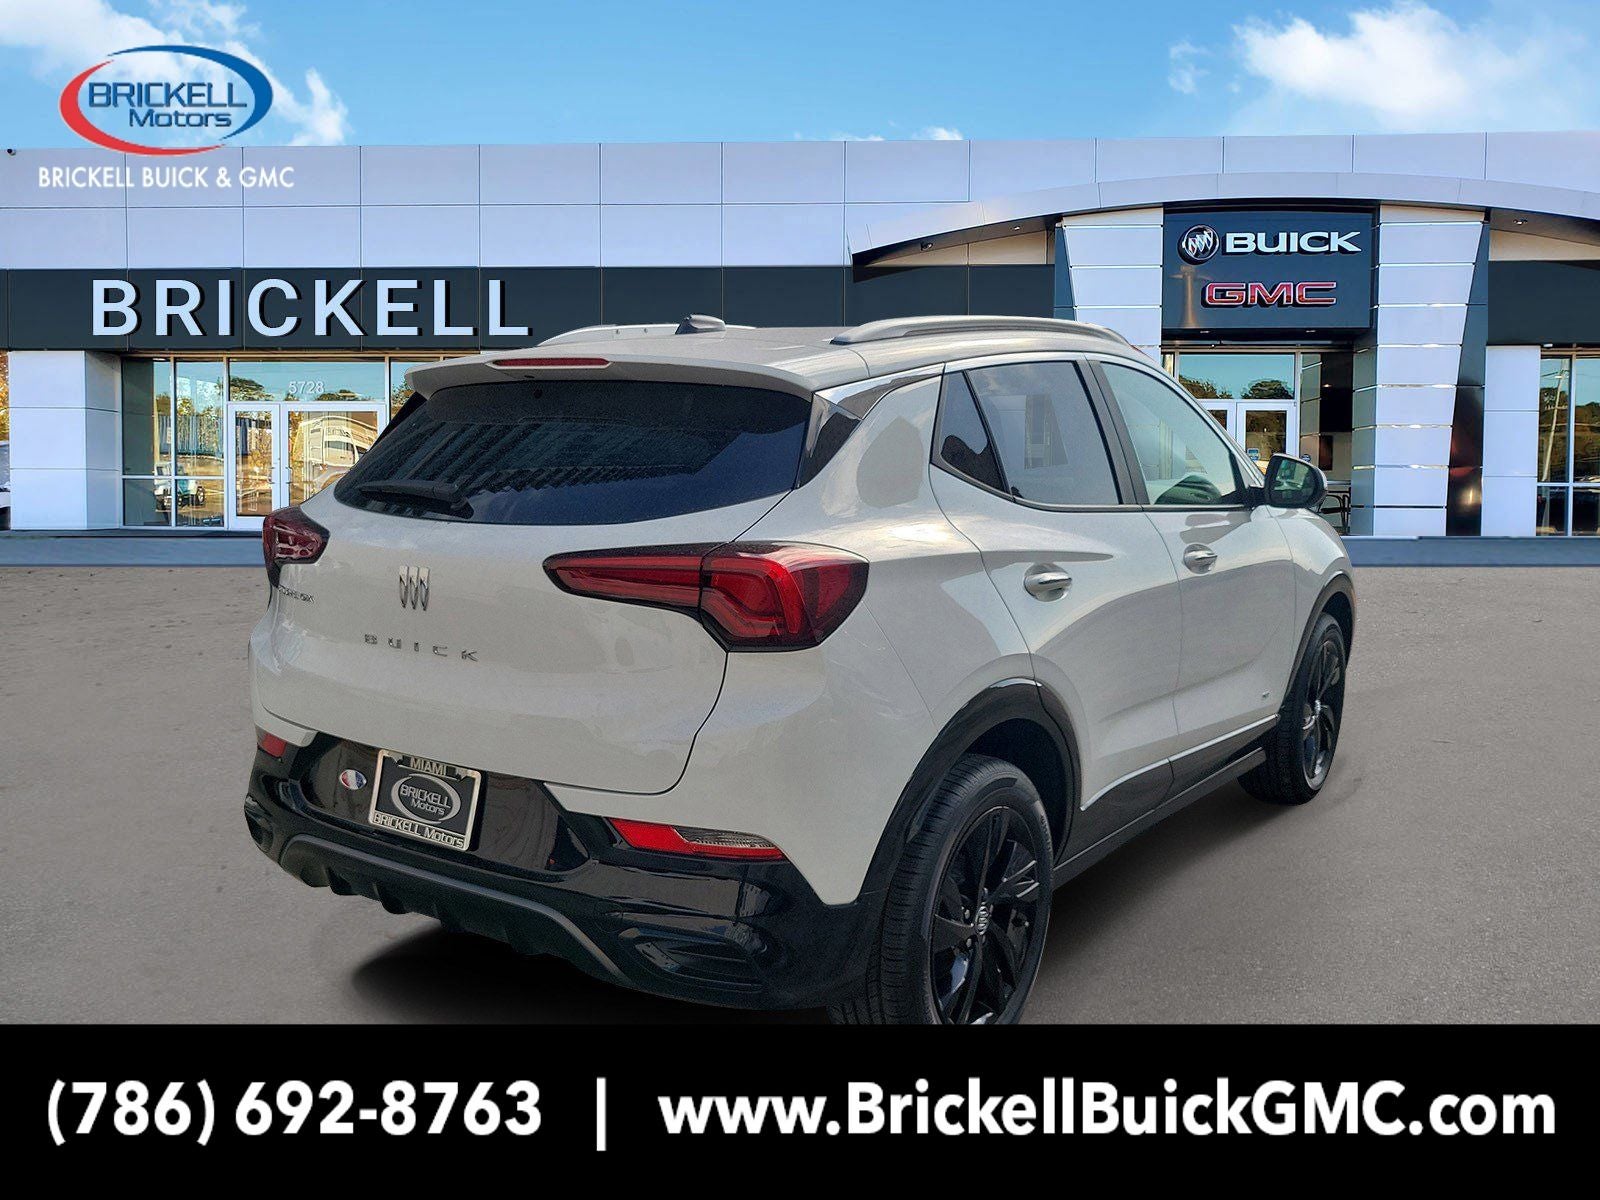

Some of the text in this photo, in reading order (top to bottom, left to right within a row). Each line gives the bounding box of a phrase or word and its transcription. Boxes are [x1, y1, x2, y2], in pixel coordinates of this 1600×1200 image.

[1225, 231, 1361, 254] BUICK
[1205, 281, 1337, 306] GMC
[92, 279, 530, 337] BRICKELL
[288, 380, 325, 394] 5728
[364, 633, 479, 662] BUICK
[410, 757, 446, 776] MIAMI
[400, 784, 451, 809] BRICKELL
[411, 799, 445, 816] Motors
[374, 814, 464, 848] BRICKELL Motors
